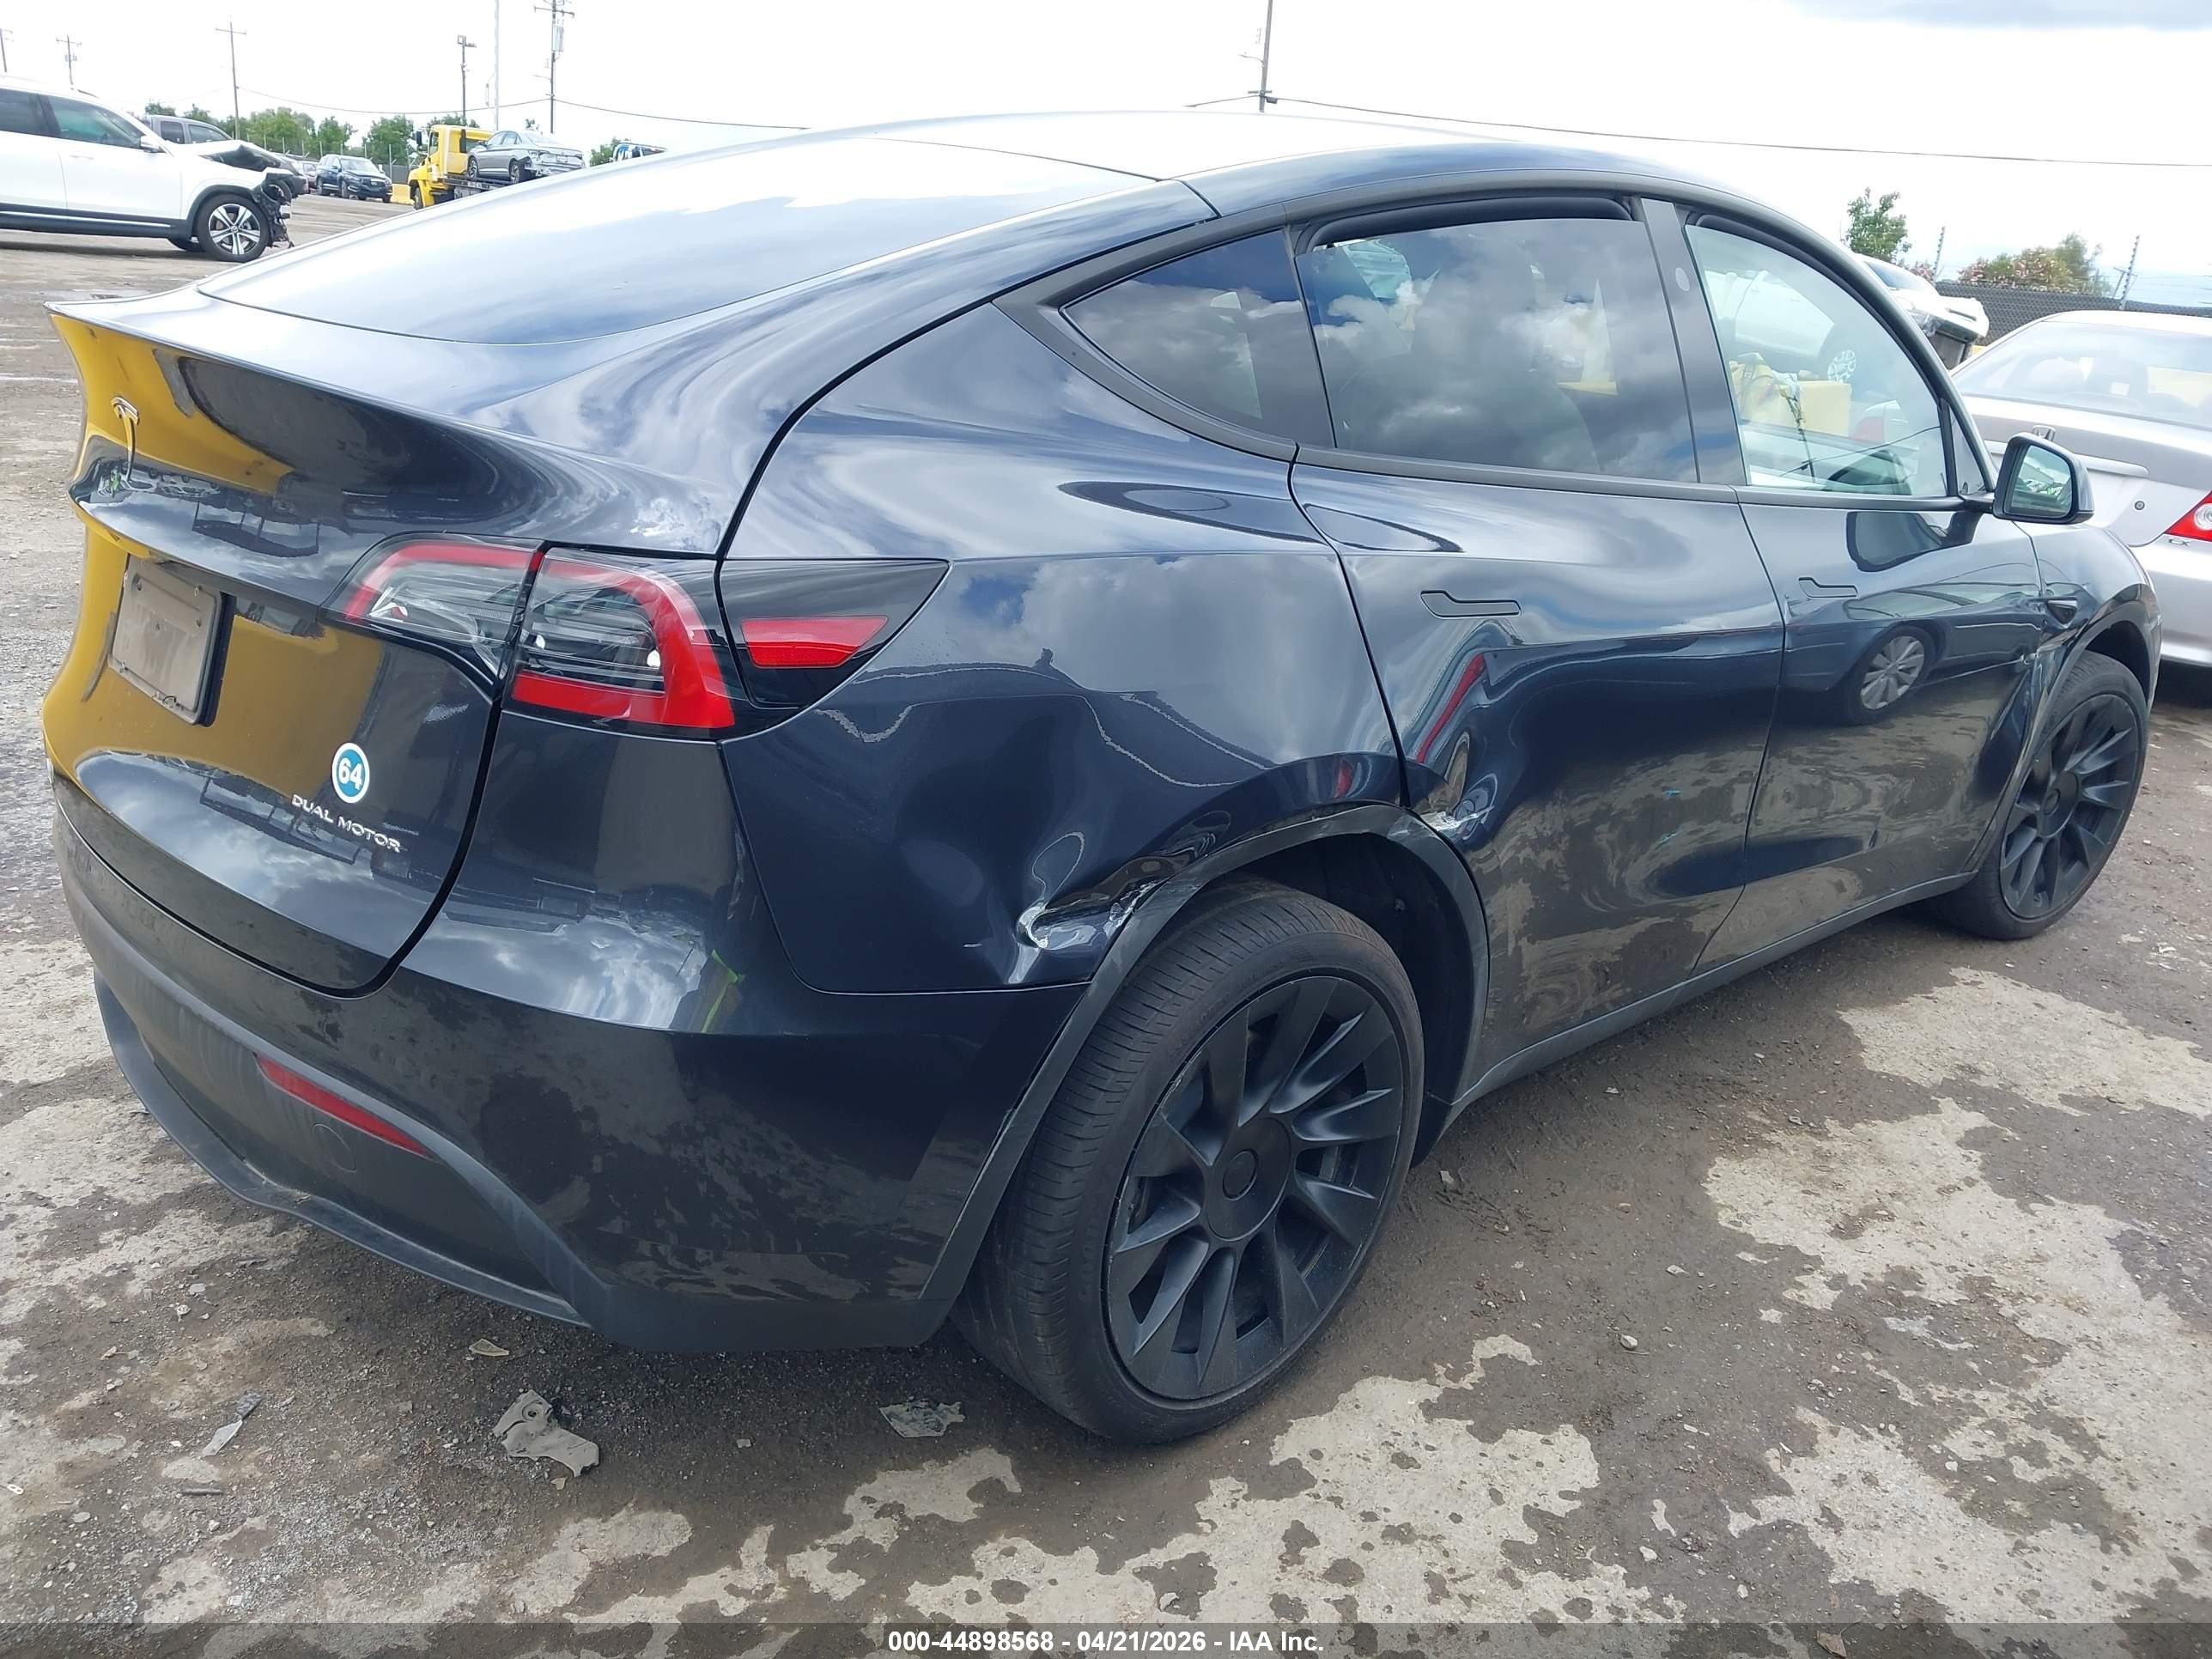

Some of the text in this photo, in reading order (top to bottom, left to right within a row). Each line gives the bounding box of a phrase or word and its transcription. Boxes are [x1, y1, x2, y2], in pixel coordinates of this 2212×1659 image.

[338, 758, 362, 790] 64
[292, 794, 400, 852] DUAL MOTOR
